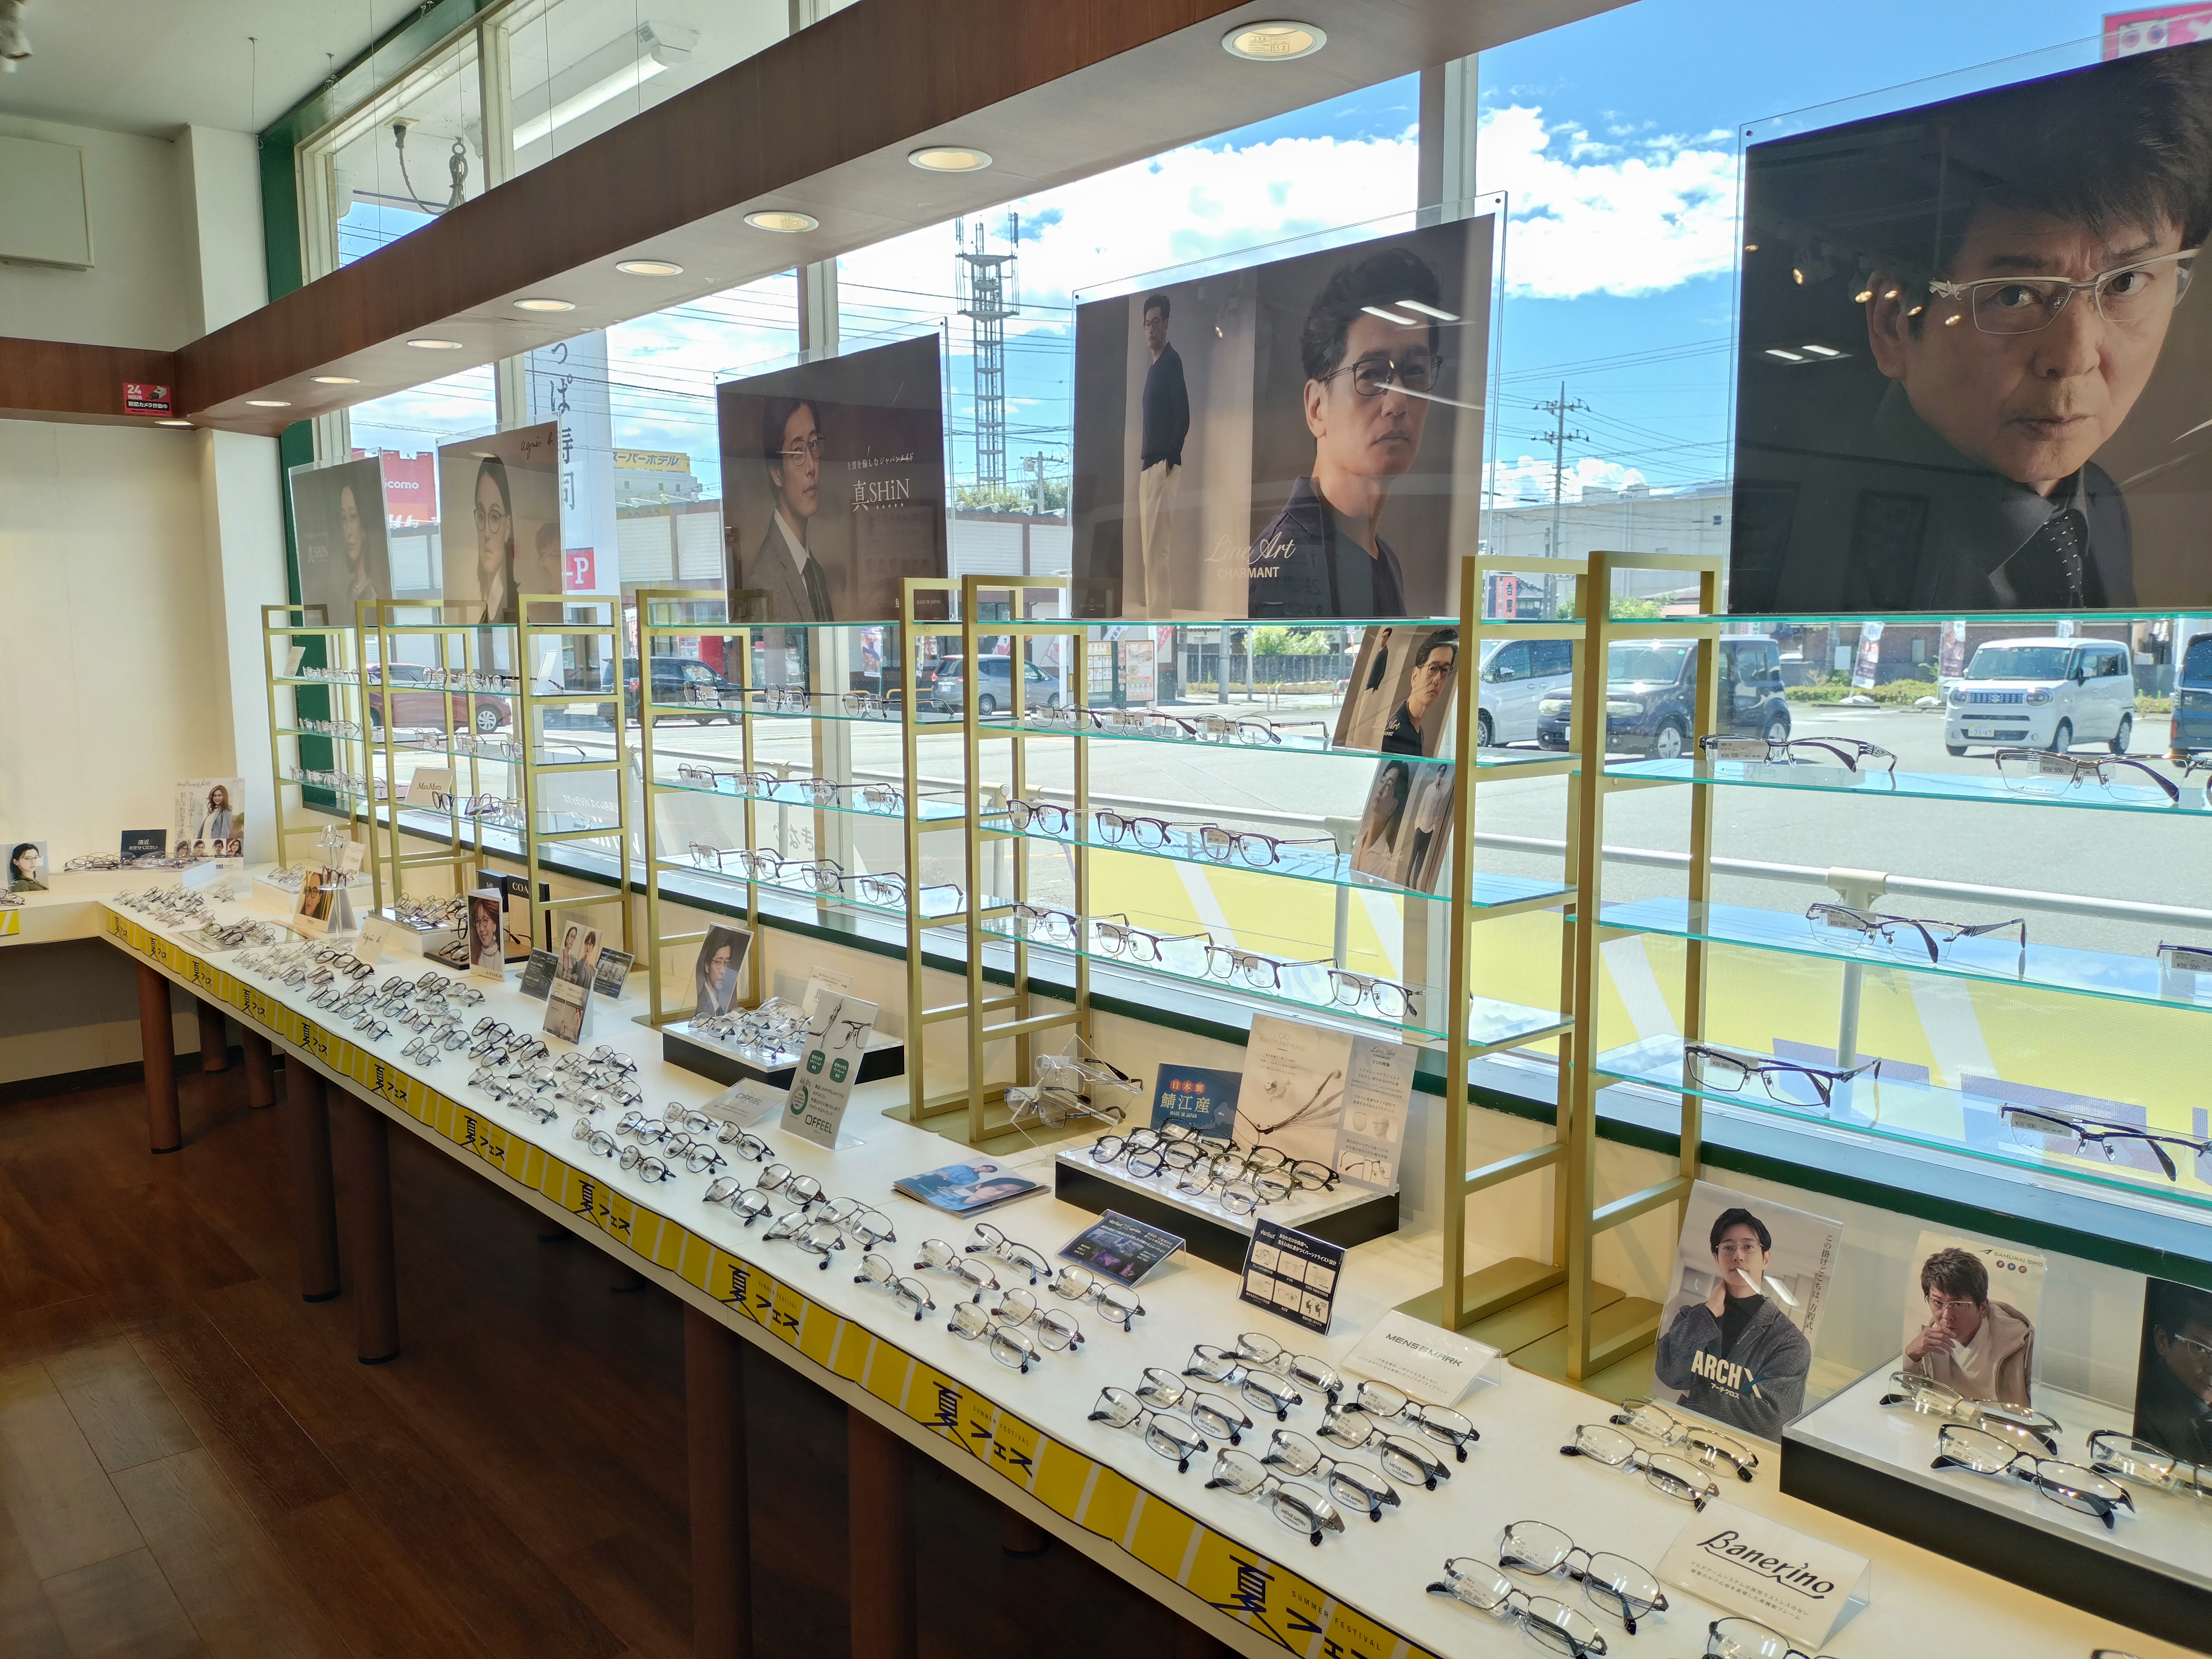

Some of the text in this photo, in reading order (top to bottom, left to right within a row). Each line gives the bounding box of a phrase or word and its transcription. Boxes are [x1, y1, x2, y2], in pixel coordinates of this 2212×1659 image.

[127, 384, 142, 394] 24
[384, 478, 419, 489] como
[1204, 531, 1296, 564] Line Art
[1218, 566, 1280, 579] CHARMANT
[416, 781, 442, 790] MaxMara
[512, 882, 529, 893] COA
[486, 971, 503, 979] COACH
[1260, 1036, 1306, 1052] CHARMANT MADE
[372, 1064, 408, 1103] 夏フェス
[1172, 1081, 1203, 1093] 日本製
[735, 1093, 764, 1105] OFFEEL
[1160, 1092, 1211, 1113] 鯖江産
[805, 1114, 832, 1134] OFFEEL
[461, 1115, 505, 1161] 夏フェス
[573, 1179, 630, 1236] 夏フェス
[1994, 1251, 2025, 1262] SAMURAI
[721, 1264, 800, 1336] 夏フェス
[758, 1281, 797, 1310] SUMMER FESTIVAL
[1385, 1333, 1463, 1367] MENS MARK
[1710, 1383, 1740, 1400] アーチクロス
[920, 1380, 1032, 1479] 夏フェス
[973, 1405, 1029, 1447] SUMMER FESTIVAL
[1389, 1462, 1415, 1479] MENS MARK
[1350, 1496, 1364, 1505] MARK
[1281, 1509, 1307, 1527] MENS MARK
[1691, 1561, 1809, 1616] マルチアームシステムの採用でストレスのない
[1206, 1554, 1369, 1659] 夏フェ
[1292, 1590, 1381, 1651] SUMMER FESTIVAL
